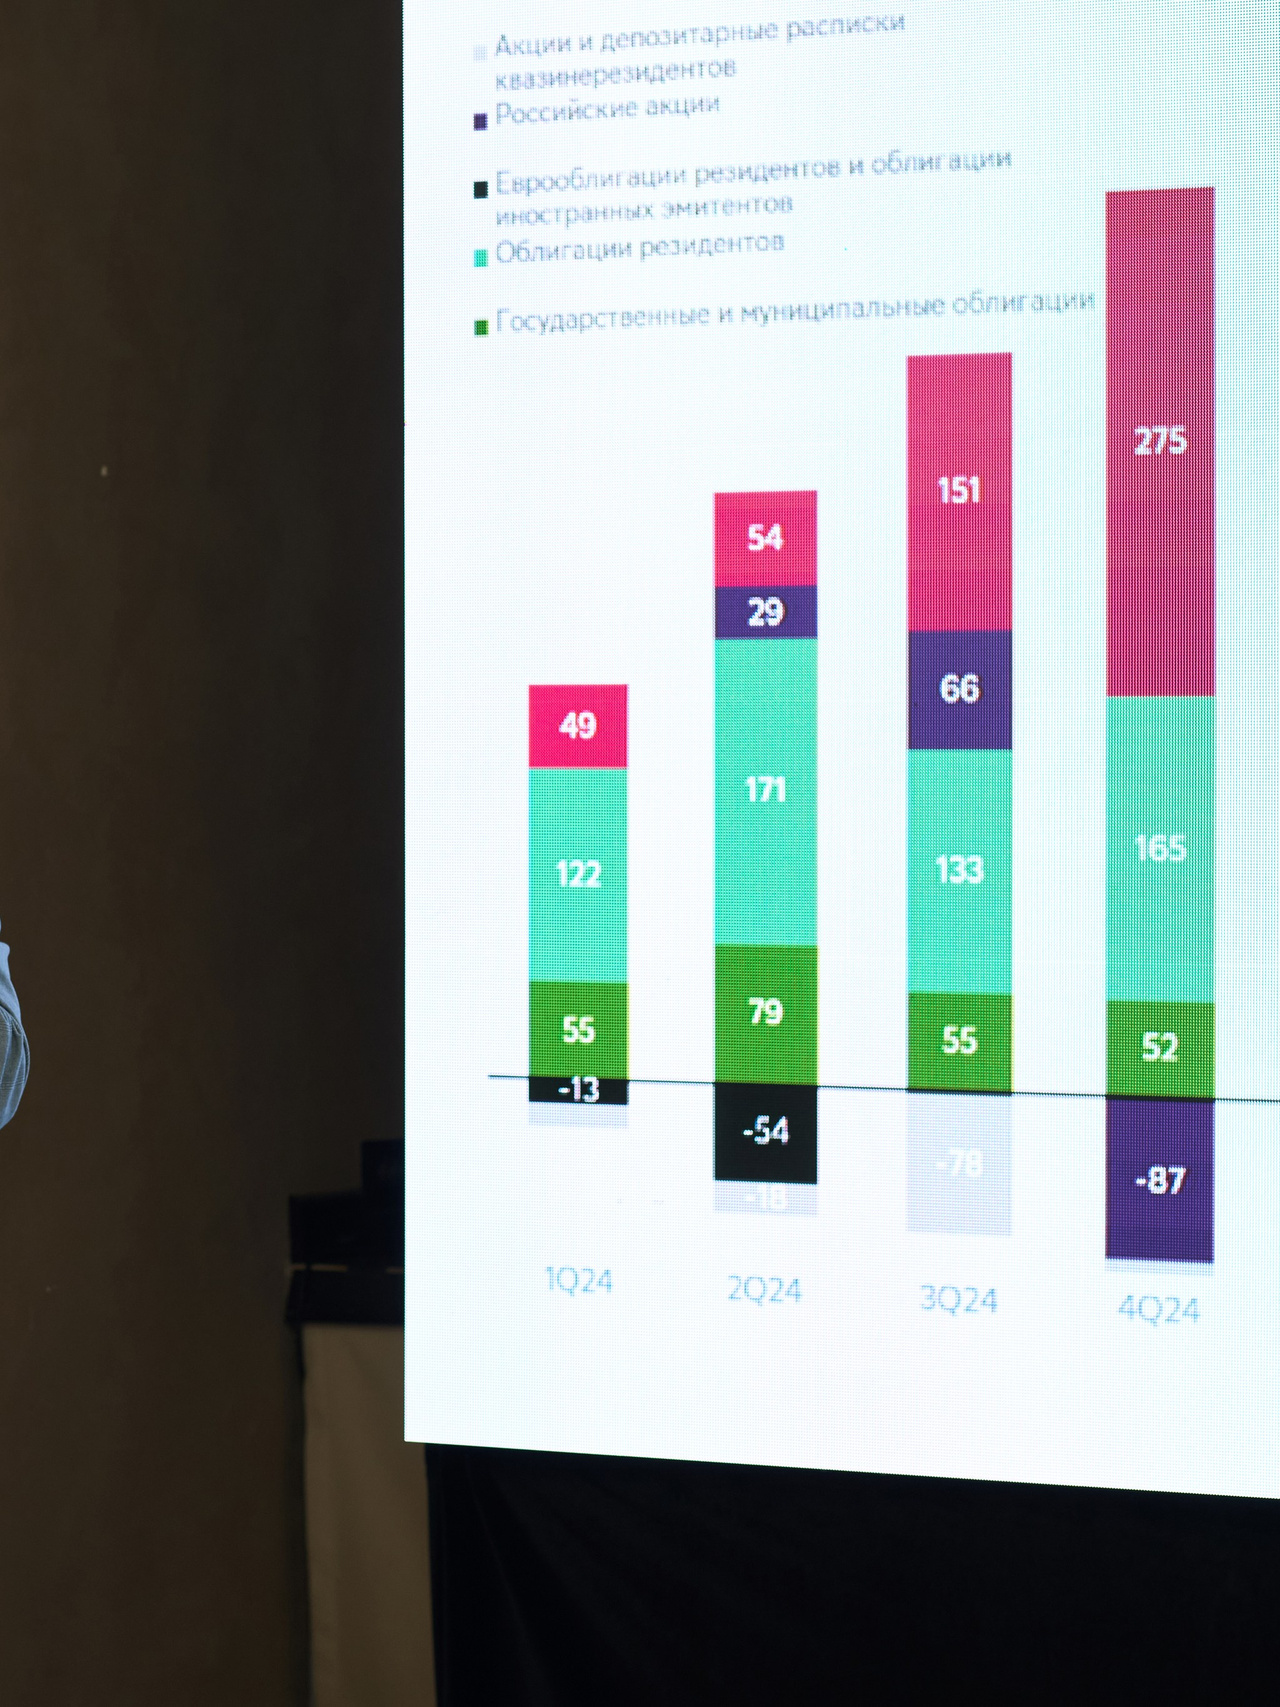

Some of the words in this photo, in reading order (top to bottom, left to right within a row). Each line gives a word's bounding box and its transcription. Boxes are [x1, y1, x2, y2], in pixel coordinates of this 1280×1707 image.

[494, 34, 571, 59] Акции
[579, 34, 593, 52] и
[600, 22, 778, 54] депозитарные
[786, 14, 906, 44] расписки
[495, 58, 736, 91] квазинерезидентов
[496, 98, 638, 125] Российские
[647, 95, 720, 119] акции
[496, 166, 688, 197] Еврооблигации
[695, 158, 841, 188] резидентов
[850, 156, 865, 176] и
[872, 149, 1013, 175] облигации
[496, 204, 653, 230] иностранных
[661, 195, 794, 220] эмитентов
[496, 239, 632, 263] Облигации
[640, 234, 786, 262] резидентов
[496, 303, 710, 335] Государственные
[719, 304, 734, 325] и
[741, 297, 946, 328] муниципальные
[952, 288, 1096, 318] облигации
[1134, 426, 1187, 456] 275
[938, 475, 981, 504] 151
[747, 524, 784, 551] 54
[747, 597, 785, 627] 29
[940, 673, 981, 704] 66
[558, 711, 597, 739] 49
[746, 776, 786, 803] 171
[1134, 834, 1187, 864] 165
[556, 859, 602, 888] 122
[936, 855, 984, 884] 133
[749, 997, 784, 1026] 79
[562, 1016, 595, 1044] 55
[942, 1025, 978, 1055] 55
[1141, 1031, 1179, 1063] 52
[558, 1075, 600, 1103] -13
[743, 1115, 790, 1145] -54
[934, 1147, 984, 1178] -78
[1135, 1165, 1189, 1195] -87
[545, 1266, 613, 1297] 1Q24
[727, 1275, 802, 1307] 2Q24
[920, 1284, 998, 1316] 3Q24
[1118, 1294, 1200, 1327] 4Q24
